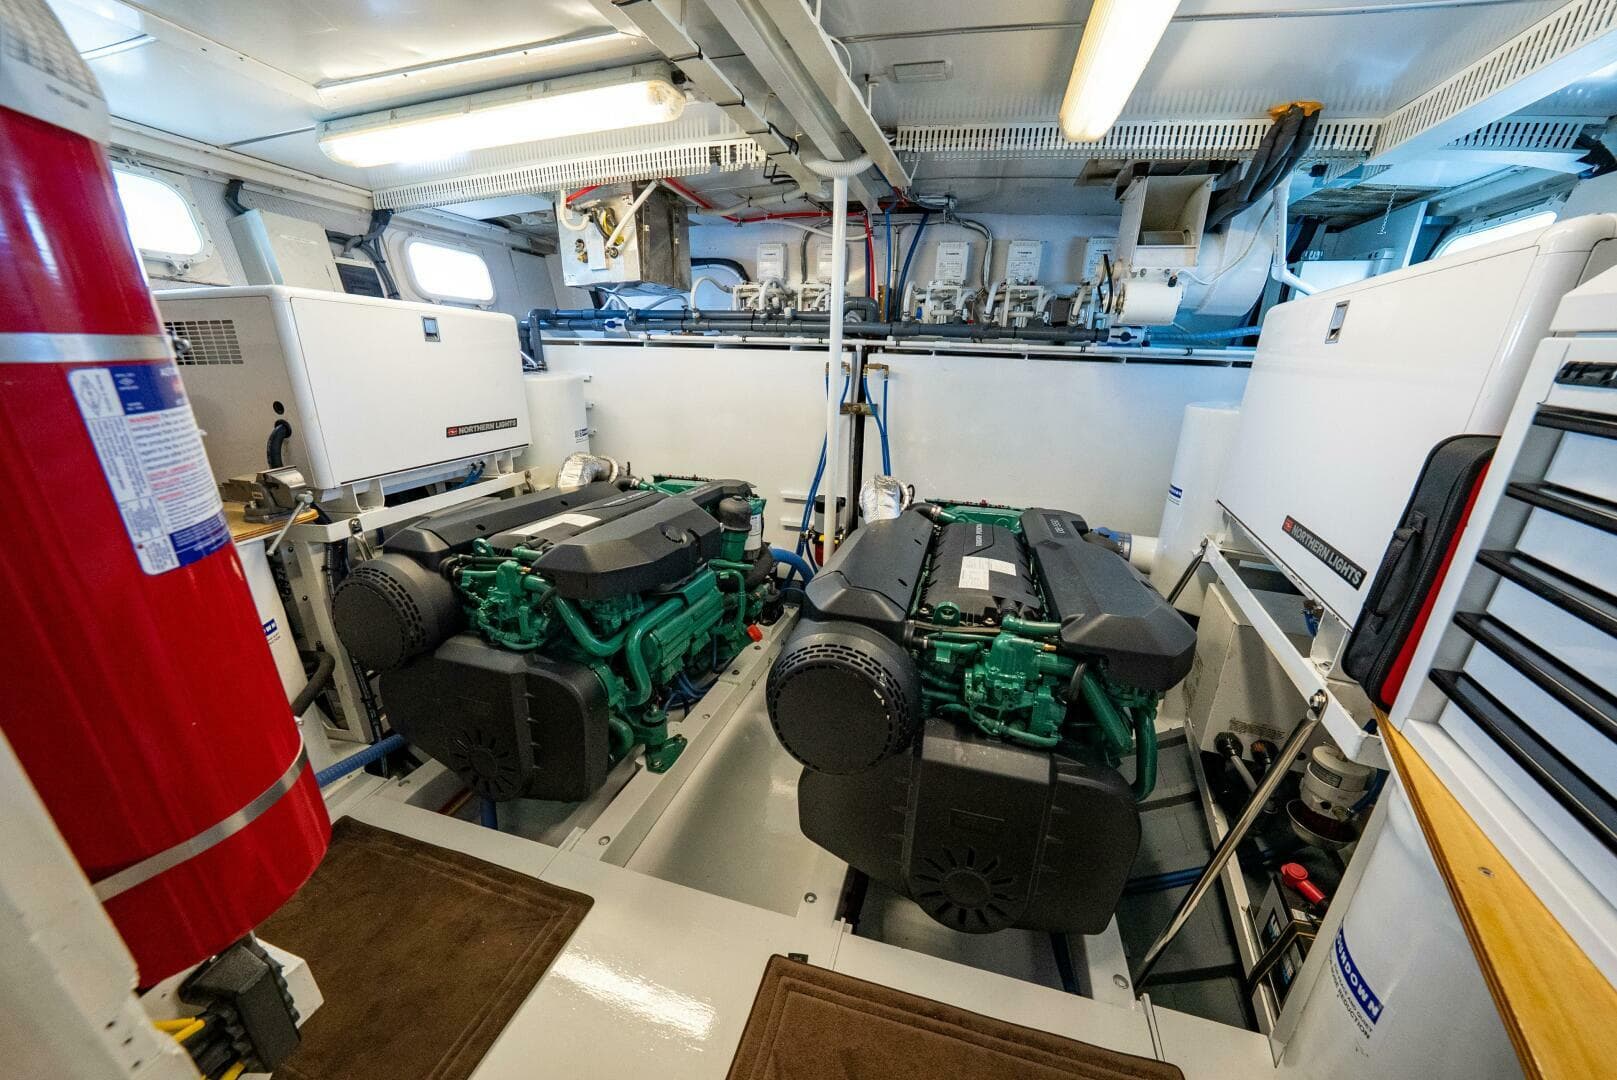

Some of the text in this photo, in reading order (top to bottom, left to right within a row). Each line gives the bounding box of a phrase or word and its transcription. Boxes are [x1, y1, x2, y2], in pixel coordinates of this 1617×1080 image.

[458, 420, 516, 435] NORTHERN LIGHTS
[1291, 524, 1362, 585] NORTHERN LIGHTS
[1337, 989, 1370, 1039] REDUCTION
[1356, 1010, 1374, 1033] QUIET
